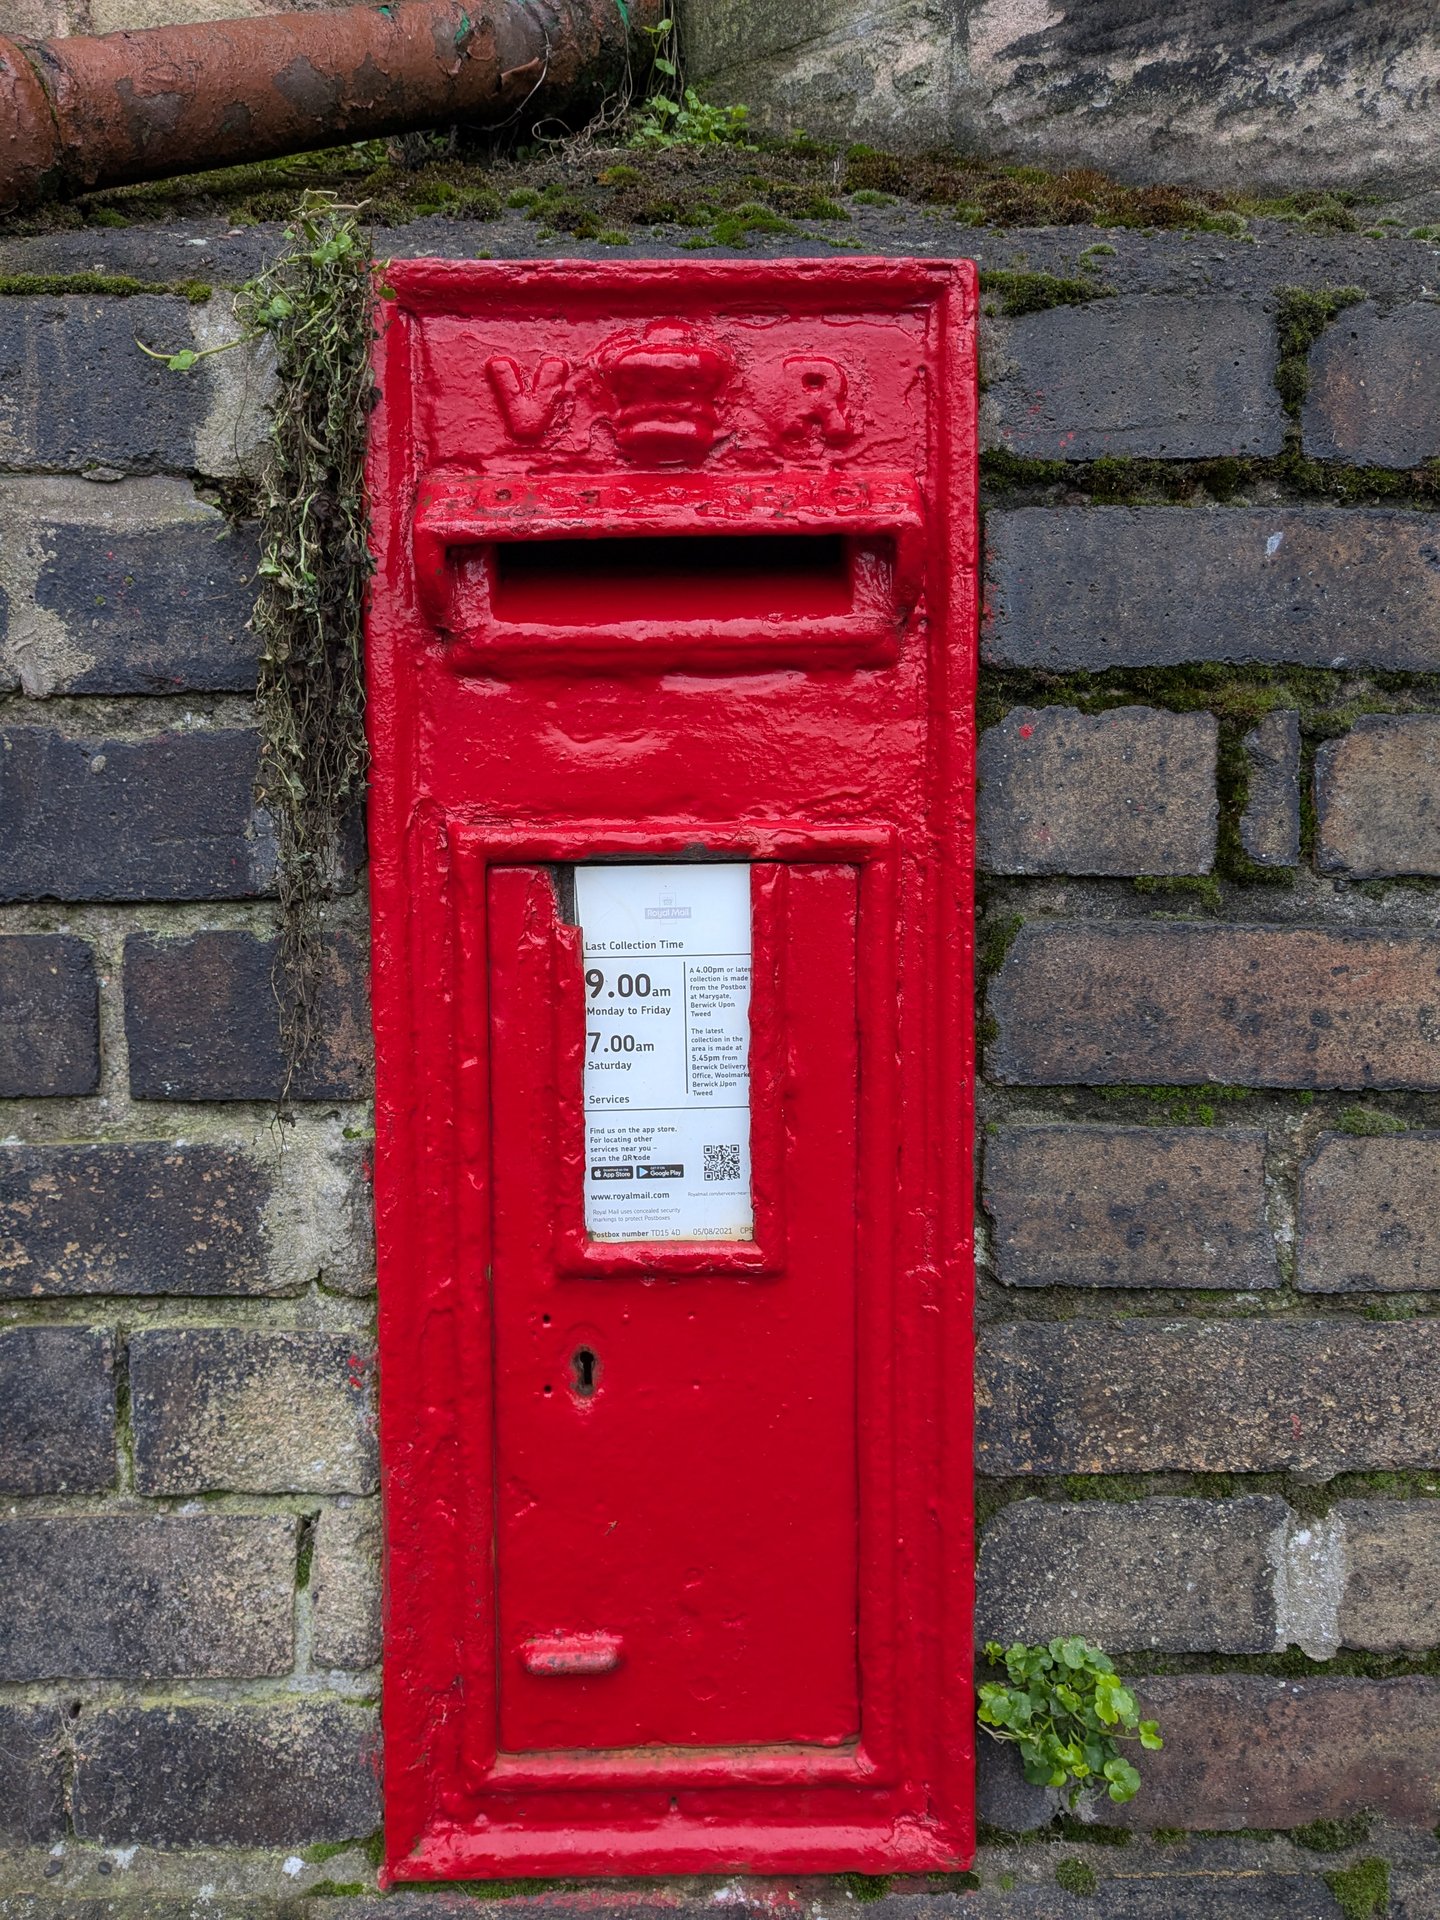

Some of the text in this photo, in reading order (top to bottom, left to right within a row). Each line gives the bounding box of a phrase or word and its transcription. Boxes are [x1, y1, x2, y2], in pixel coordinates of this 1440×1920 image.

[485, 355, 855, 445] V R
[647, 909, 689, 918] Royal Mail
[585, 940, 684, 951] Last Collection Time
[696, 966, 724, 974] 4.00pm
[585, 969, 671, 999] 9.00am
[699, 993, 732, 1001] Marygate,
[587, 1006, 671, 1016] Monday to Friday
[587, 1032, 655, 1053] 7.00am
[588, 1061, 632, 1071] Saturday
[589, 1095, 630, 1104] Services
[604, 1136, 631, 1144] locating
[591, 1192, 670, 1201] www.royalmail.com
